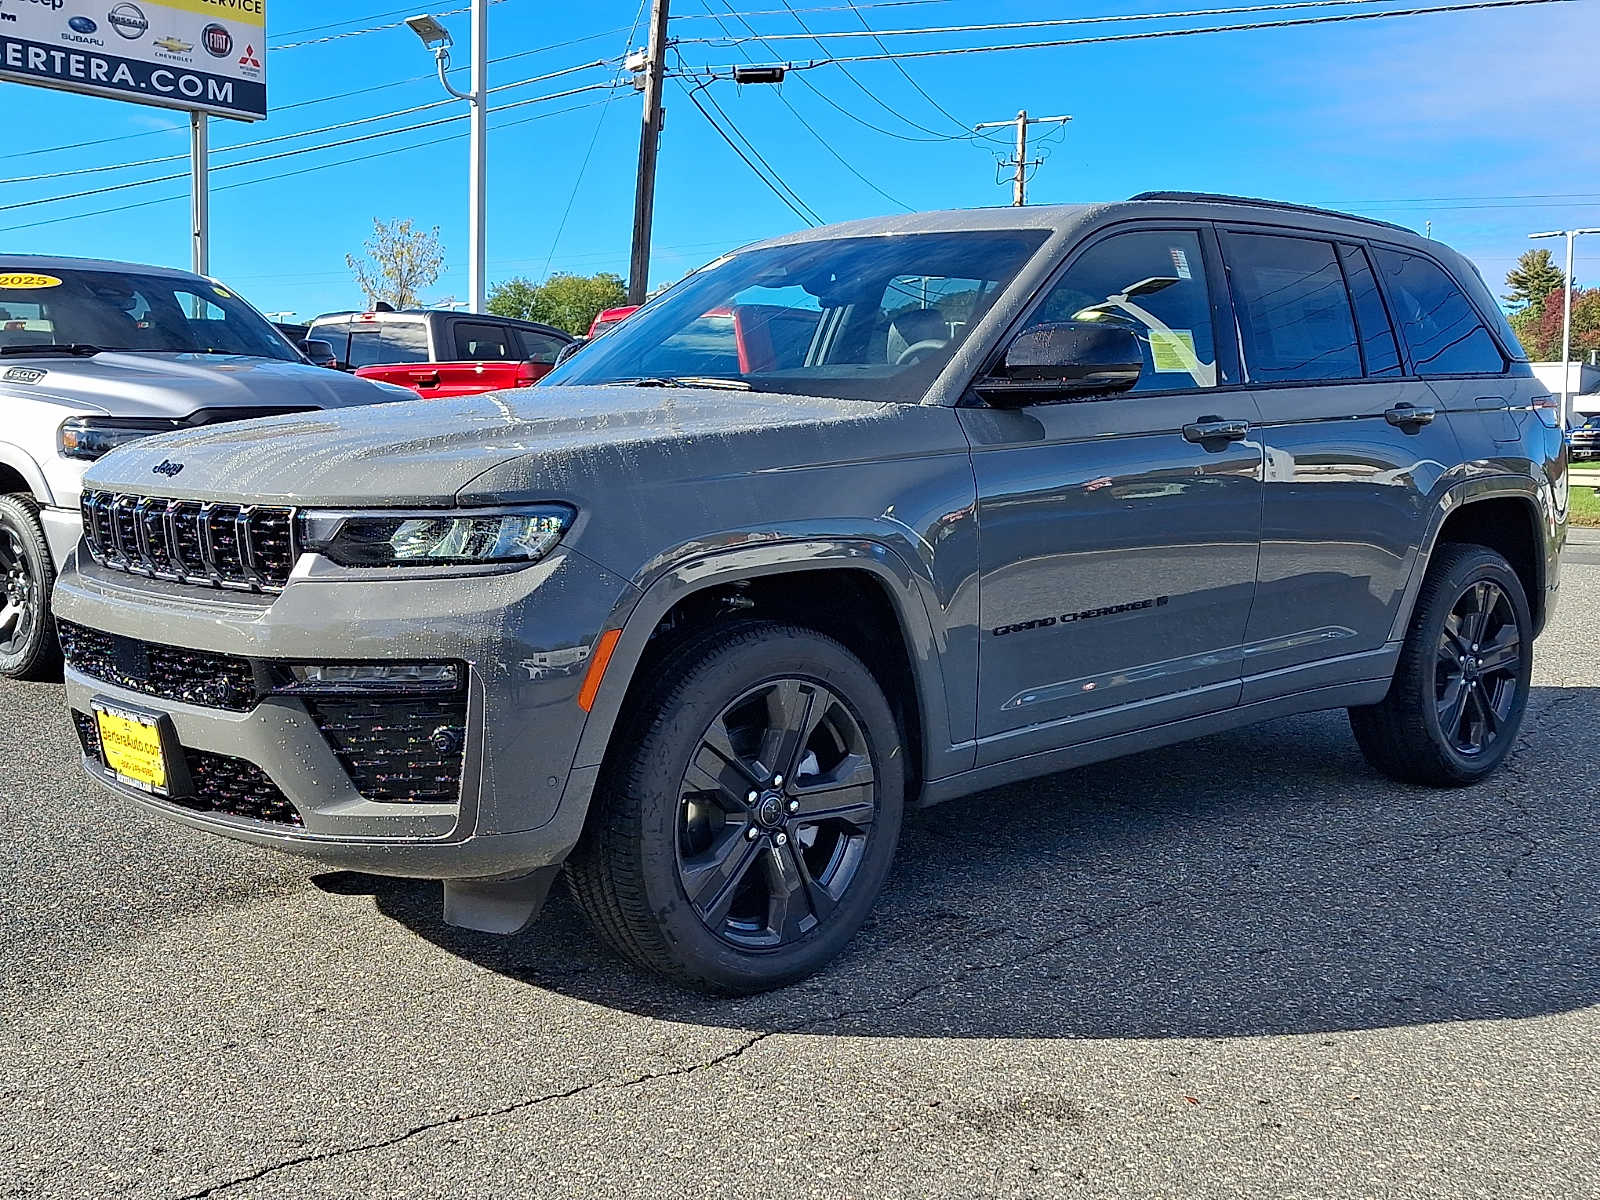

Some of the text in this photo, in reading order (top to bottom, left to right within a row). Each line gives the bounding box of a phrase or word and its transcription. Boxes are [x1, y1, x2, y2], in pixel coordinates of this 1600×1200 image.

[111, 15, 146, 28] NISSAN
[61, 33, 104, 46] SUBARU
[209, 33, 227, 50] FIAT
[154, 52, 192, 63] CHEVROLET
[0, 43, 233, 103] ERTERA.COM
[0, 276, 48, 285] 2025
[152, 459, 184, 477] Jeep
[992, 599, 1152, 636] GRAND CHEROKEE
